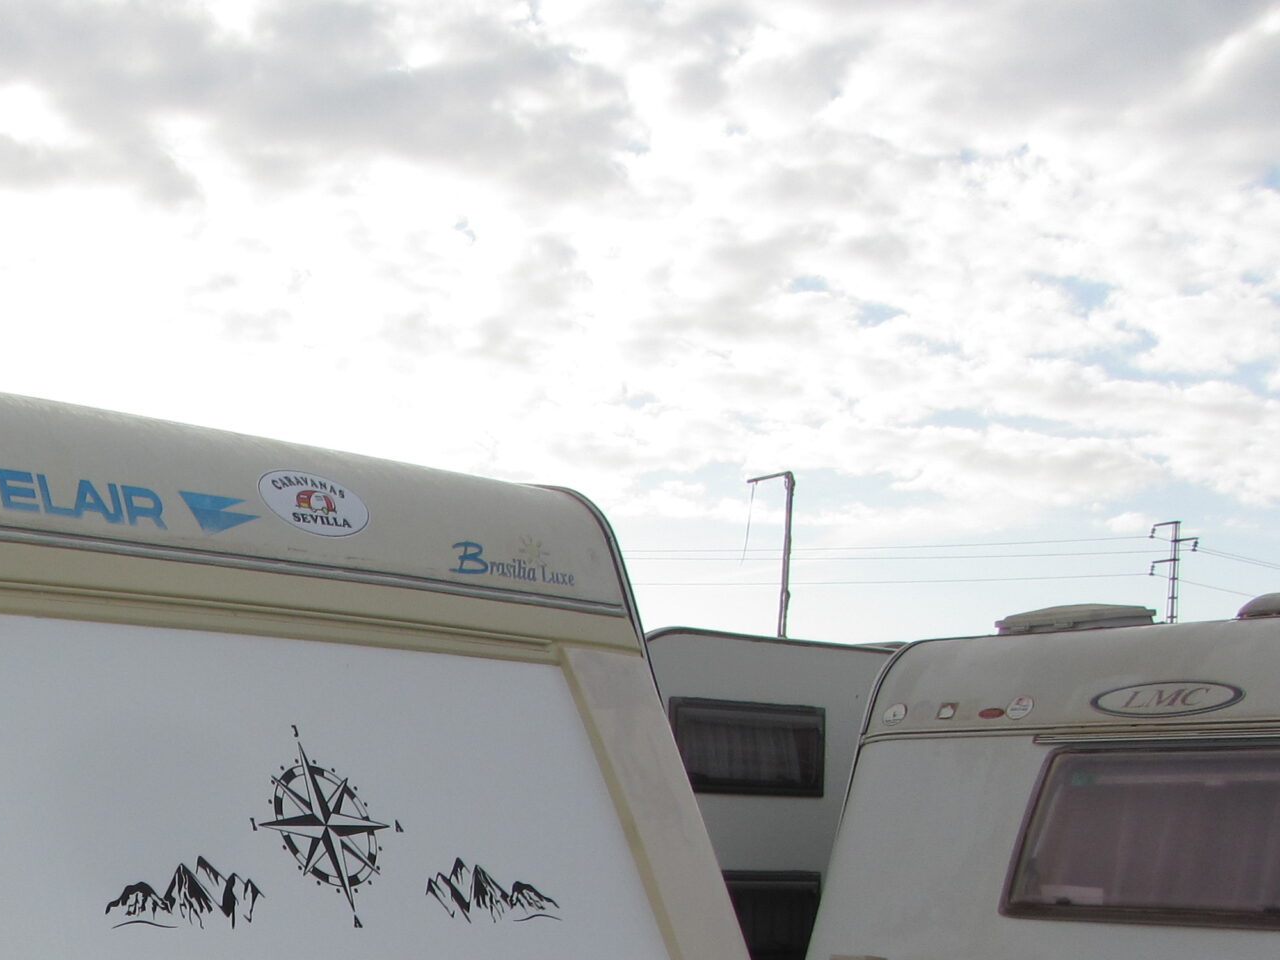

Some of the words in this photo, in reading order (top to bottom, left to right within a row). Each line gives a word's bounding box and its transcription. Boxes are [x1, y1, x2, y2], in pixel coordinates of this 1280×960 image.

[270, 475, 346, 499] CARAVANAS
[291, 511, 353, 529] SEVILLA
[448, 540, 537, 583] Brasilia
[540, 565, 576, 587] Luxe
[1121, 687, 1211, 709] LMC
